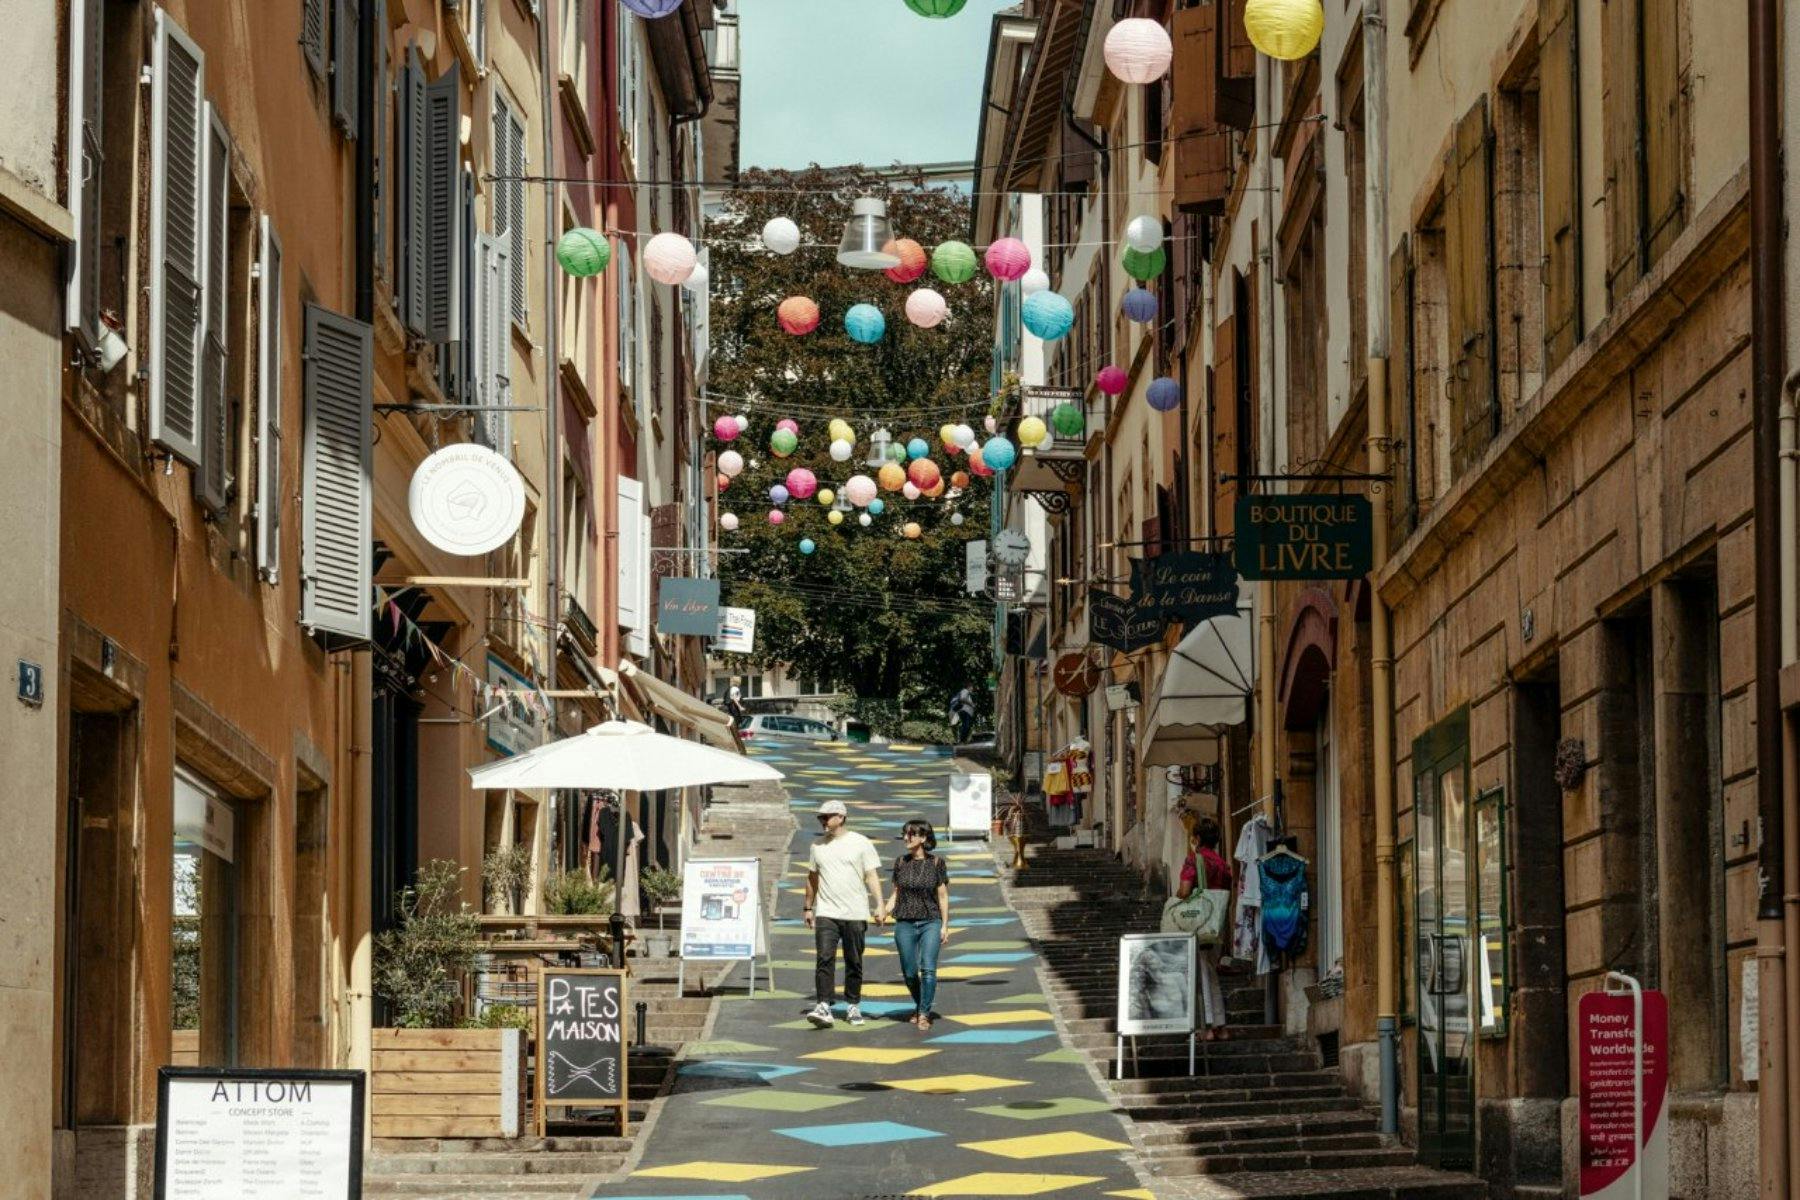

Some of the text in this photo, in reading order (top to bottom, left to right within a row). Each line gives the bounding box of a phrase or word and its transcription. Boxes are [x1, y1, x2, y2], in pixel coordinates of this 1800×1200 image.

[1250, 505, 1358, 526] BOUTIQUE
[1289, 524, 1319, 541] DU
[1259, 543, 1354, 571] LIVRE
[1156, 566, 1213, 585] Le coin
[662, 598, 679, 613] Vin
[1138, 586, 1232, 608] de la Danse
[26, 667, 36, 696] 3
[1590, 1013, 1629, 1025] Money
[547, 1020, 621, 1043] MAISON
[1590, 1028, 1638, 1039] Transfe
[1590, 1043, 1655, 1055] Worldwde
[211, 1080, 312, 1103] ATTOM
[228, 1108, 294, 1117] CONCEPT STORE
